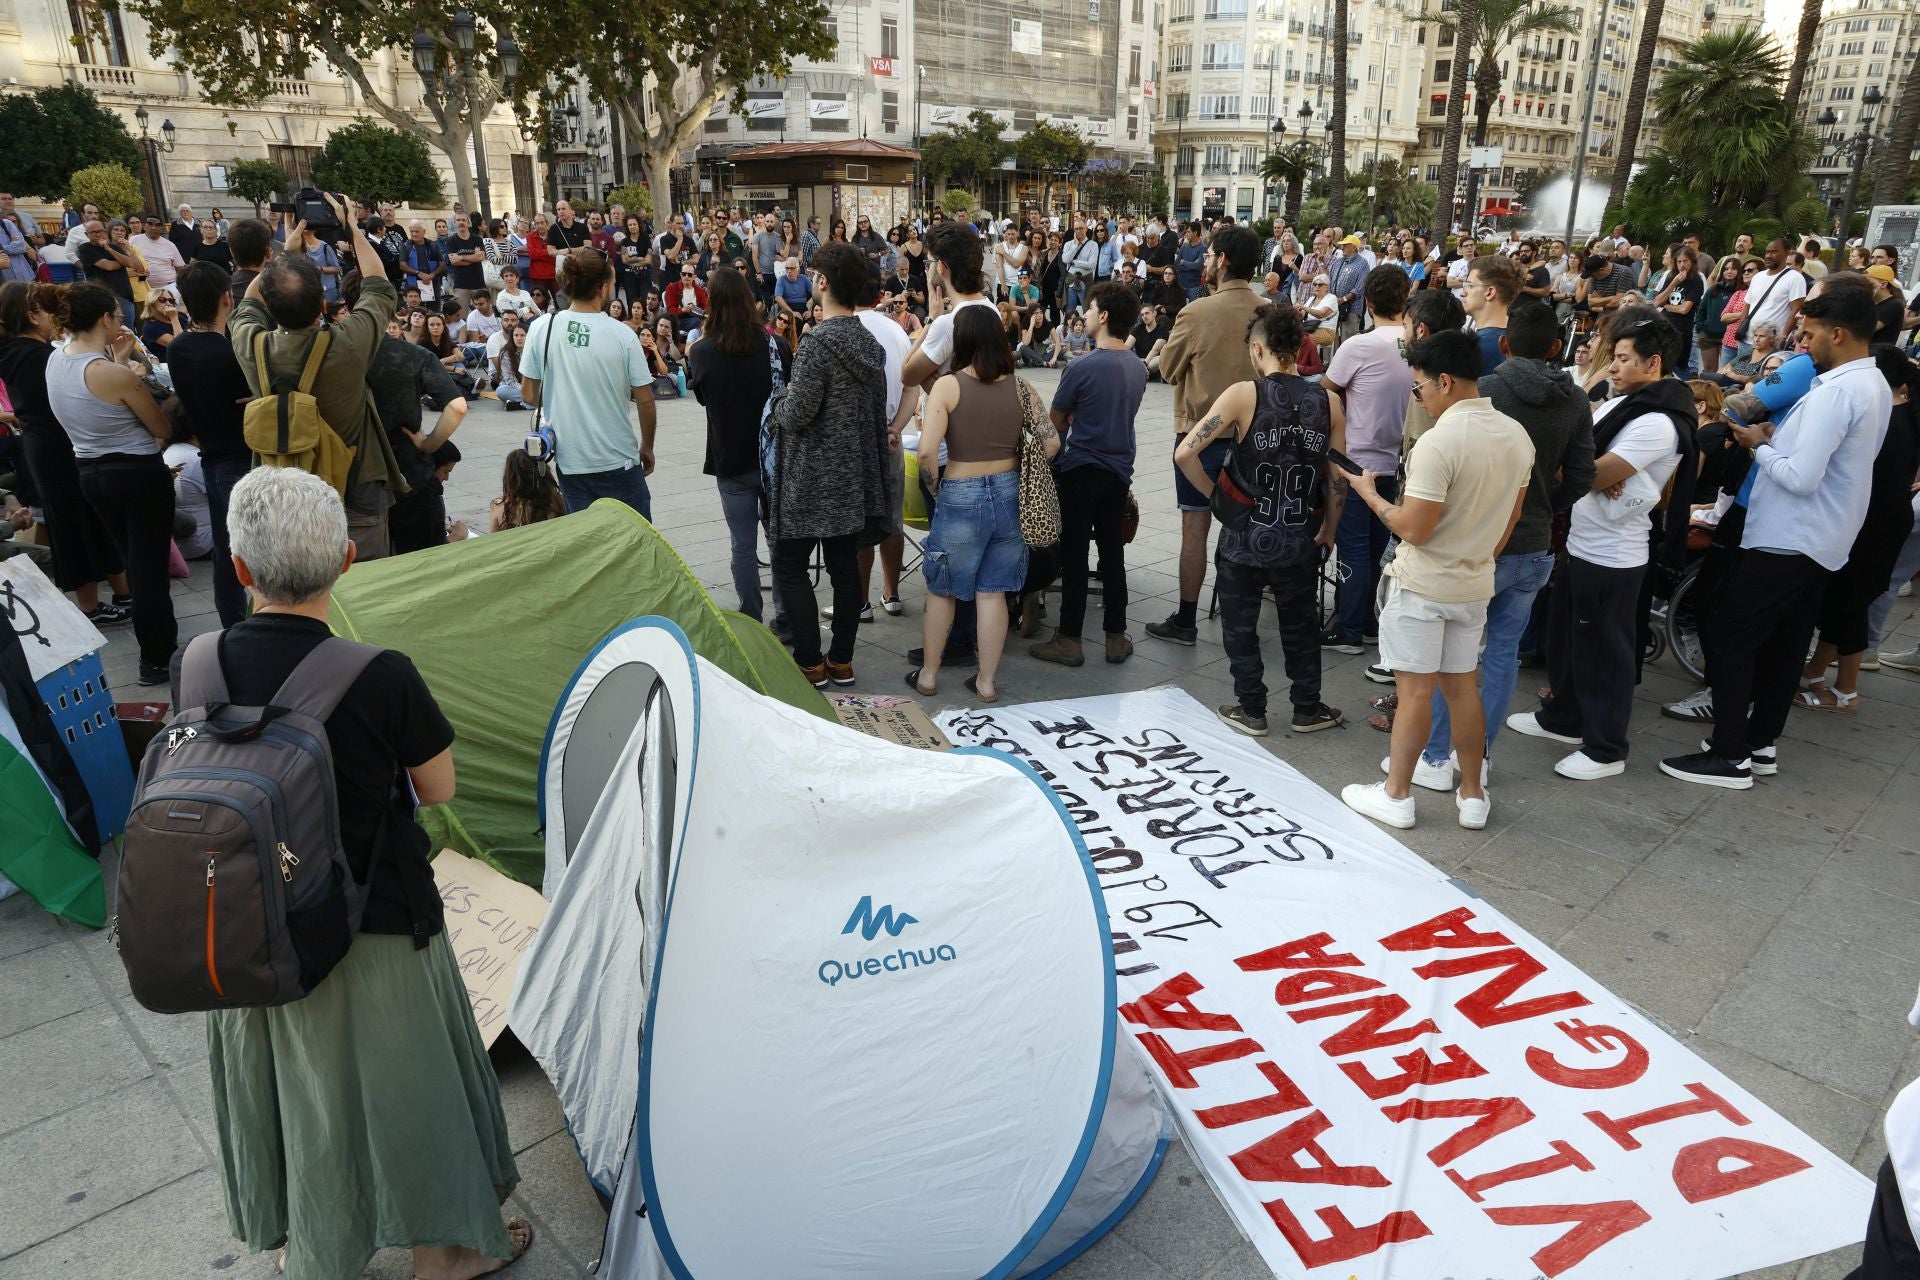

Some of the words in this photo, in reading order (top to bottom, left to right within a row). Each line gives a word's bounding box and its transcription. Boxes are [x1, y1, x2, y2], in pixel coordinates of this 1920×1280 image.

[1250, 462, 1316, 527] 99
[1028, 715, 1116, 750] DE
[1122, 728, 1334, 862] SERRANS
[1072, 749, 1271, 889] TORRES
[818, 944, 957, 987] Quechua
[1118, 971, 1434, 1270] FALTA
[1233, 931, 1653, 1279] VIVENDA
[1378, 906, 1814, 1204] DIGNA
